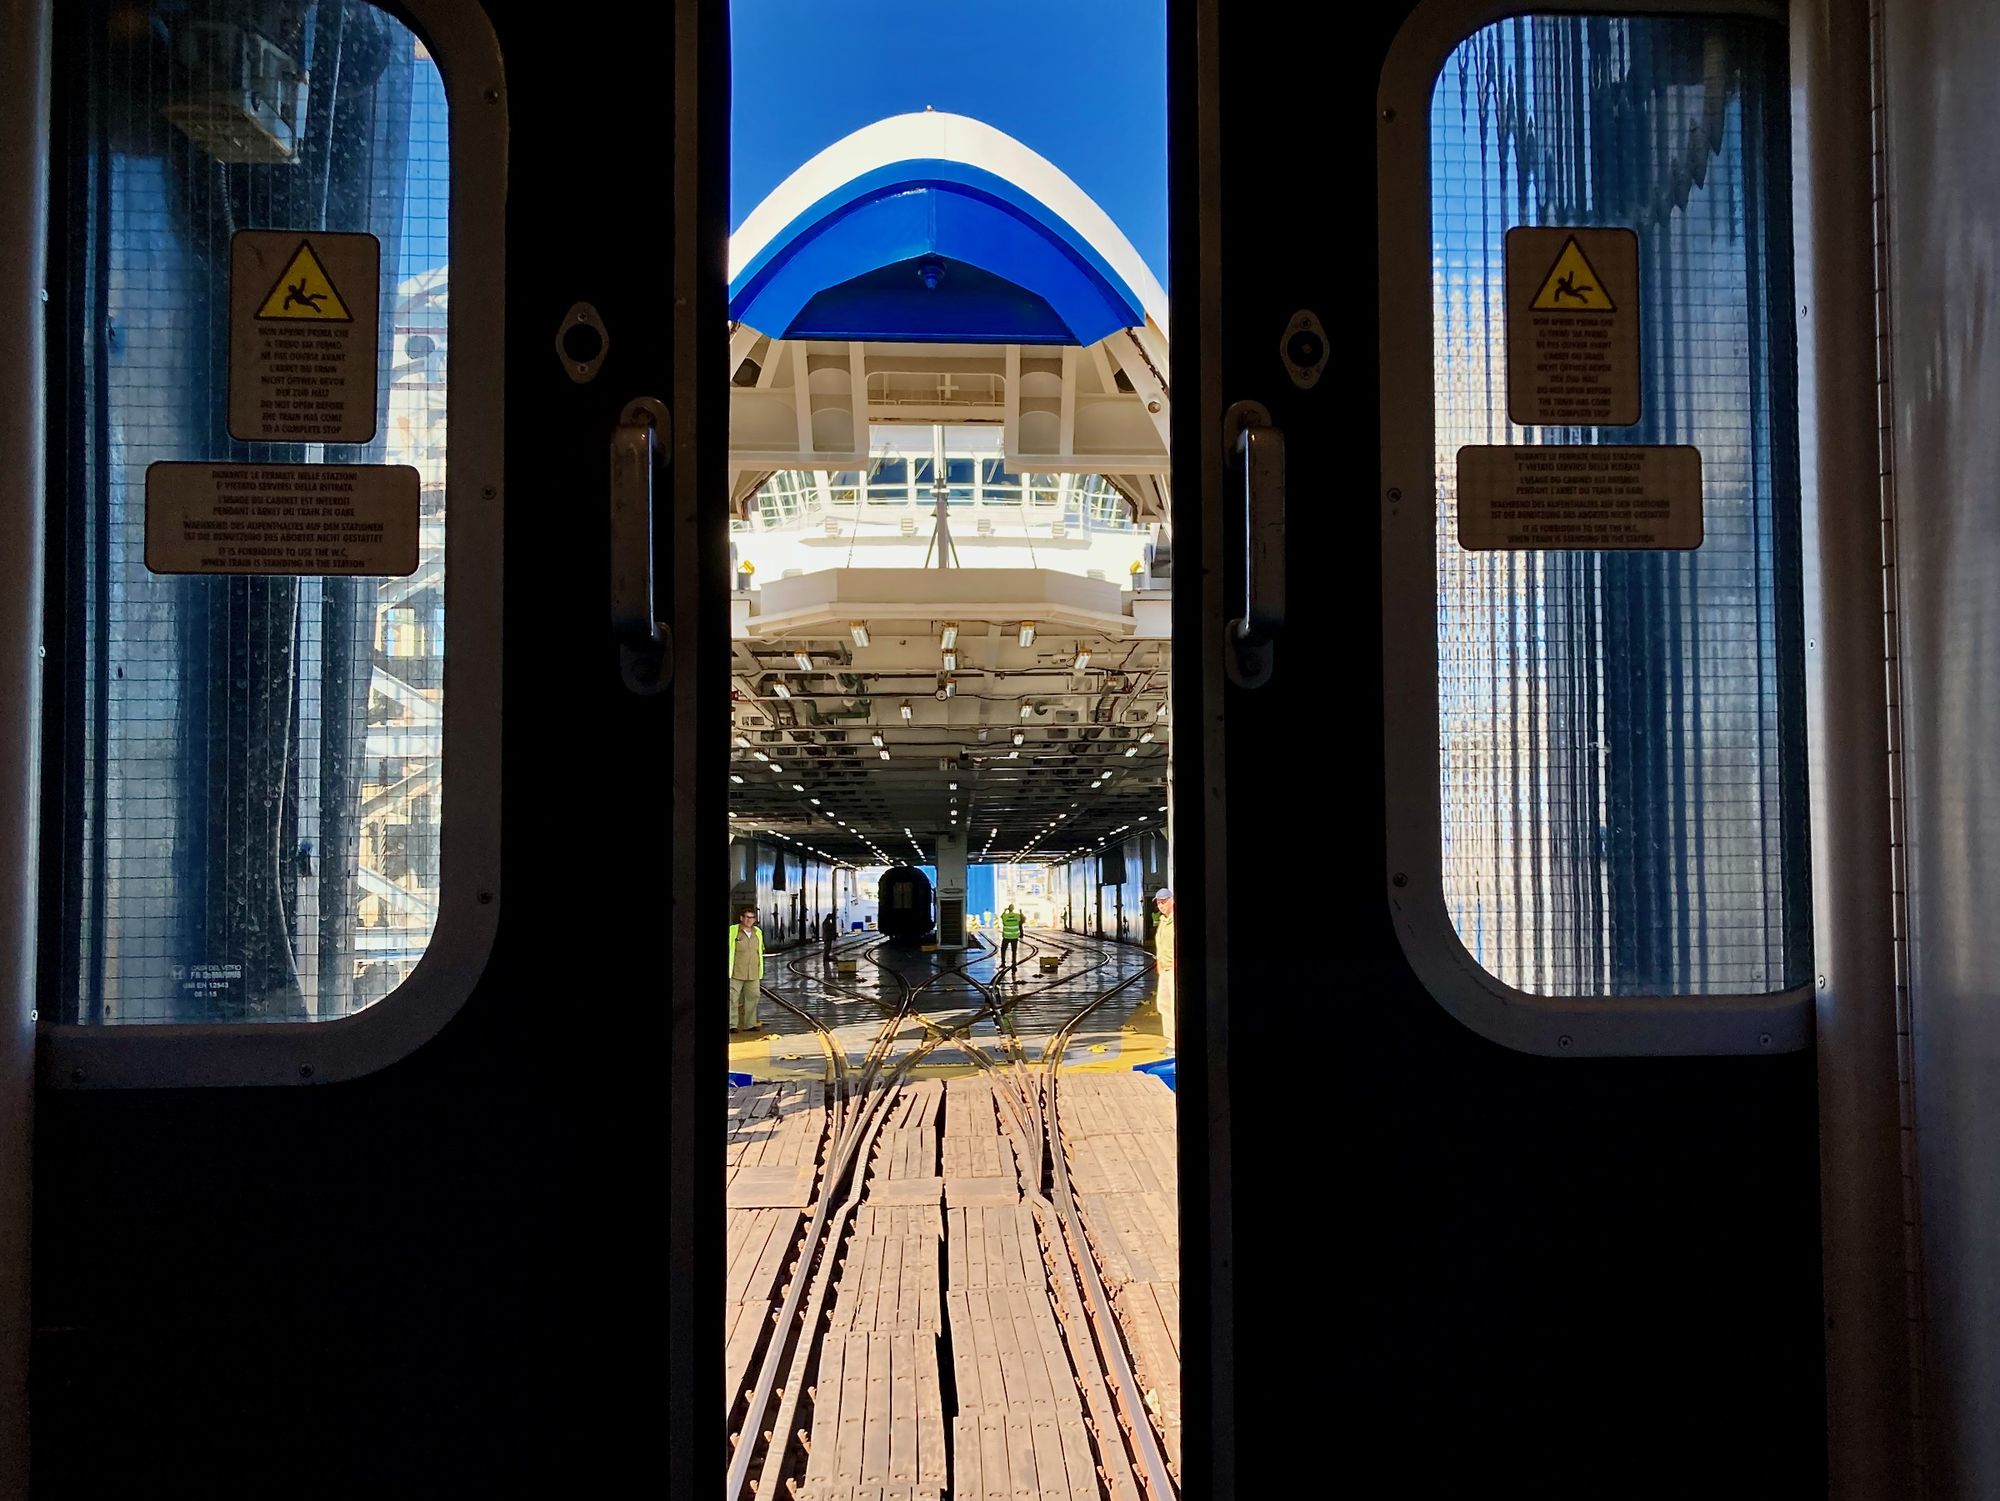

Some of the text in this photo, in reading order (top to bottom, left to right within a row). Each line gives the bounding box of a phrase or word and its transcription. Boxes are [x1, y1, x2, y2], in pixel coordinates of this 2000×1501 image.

[282, 425, 320, 433] COMPLETE
[323, 425, 341, 433] STOP
[297, 507, 319, 516] TRAIN
[238, 548, 283, 556] FORBIDDEN
[298, 548, 311, 556] USE
[315, 548, 328, 556] THE
[263, 559, 302, 568] STANDING
[317, 559, 330, 568] THE
[333, 559, 365, 568] STATION
